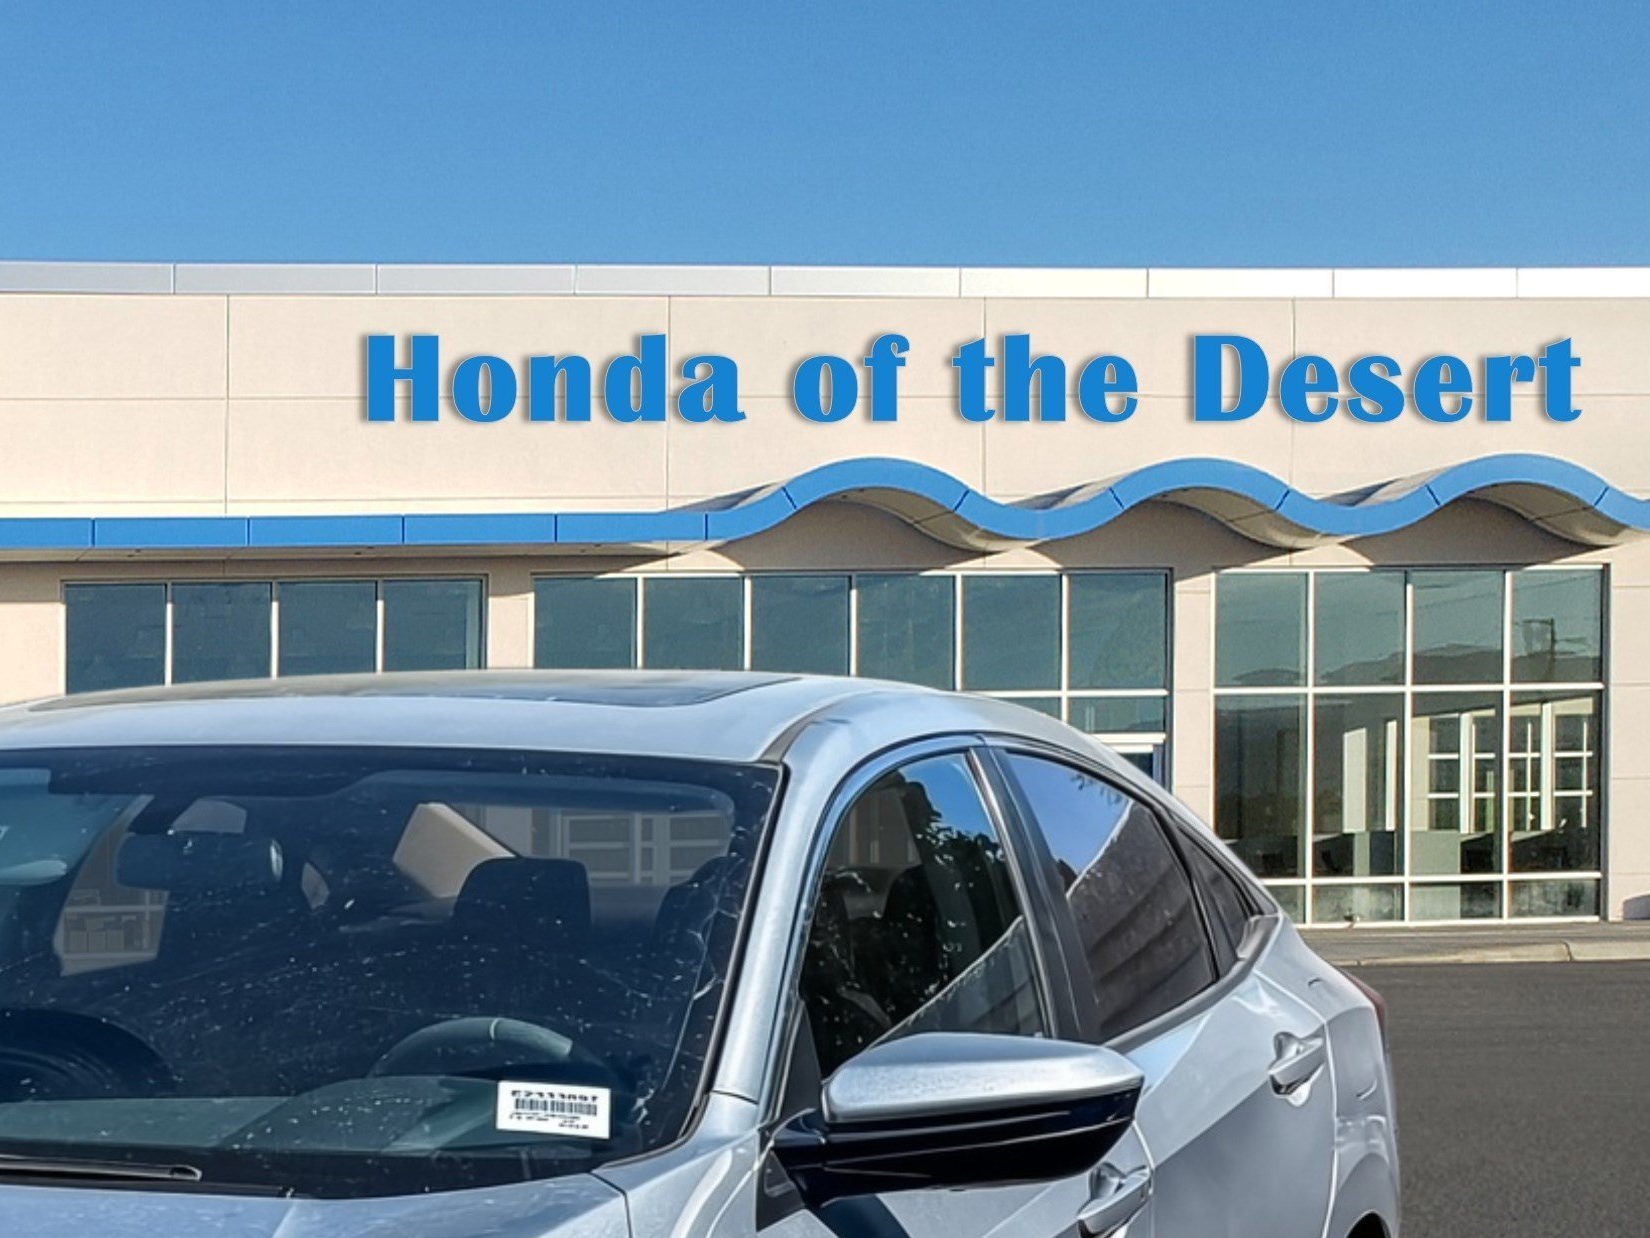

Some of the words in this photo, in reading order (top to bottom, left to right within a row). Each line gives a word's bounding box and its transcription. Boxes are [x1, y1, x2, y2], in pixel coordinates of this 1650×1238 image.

[366, 333, 747, 423] Honda
[793, 333, 911, 423] of
[951, 333, 1139, 423] the
[1193, 334, 1583, 423] Desert
